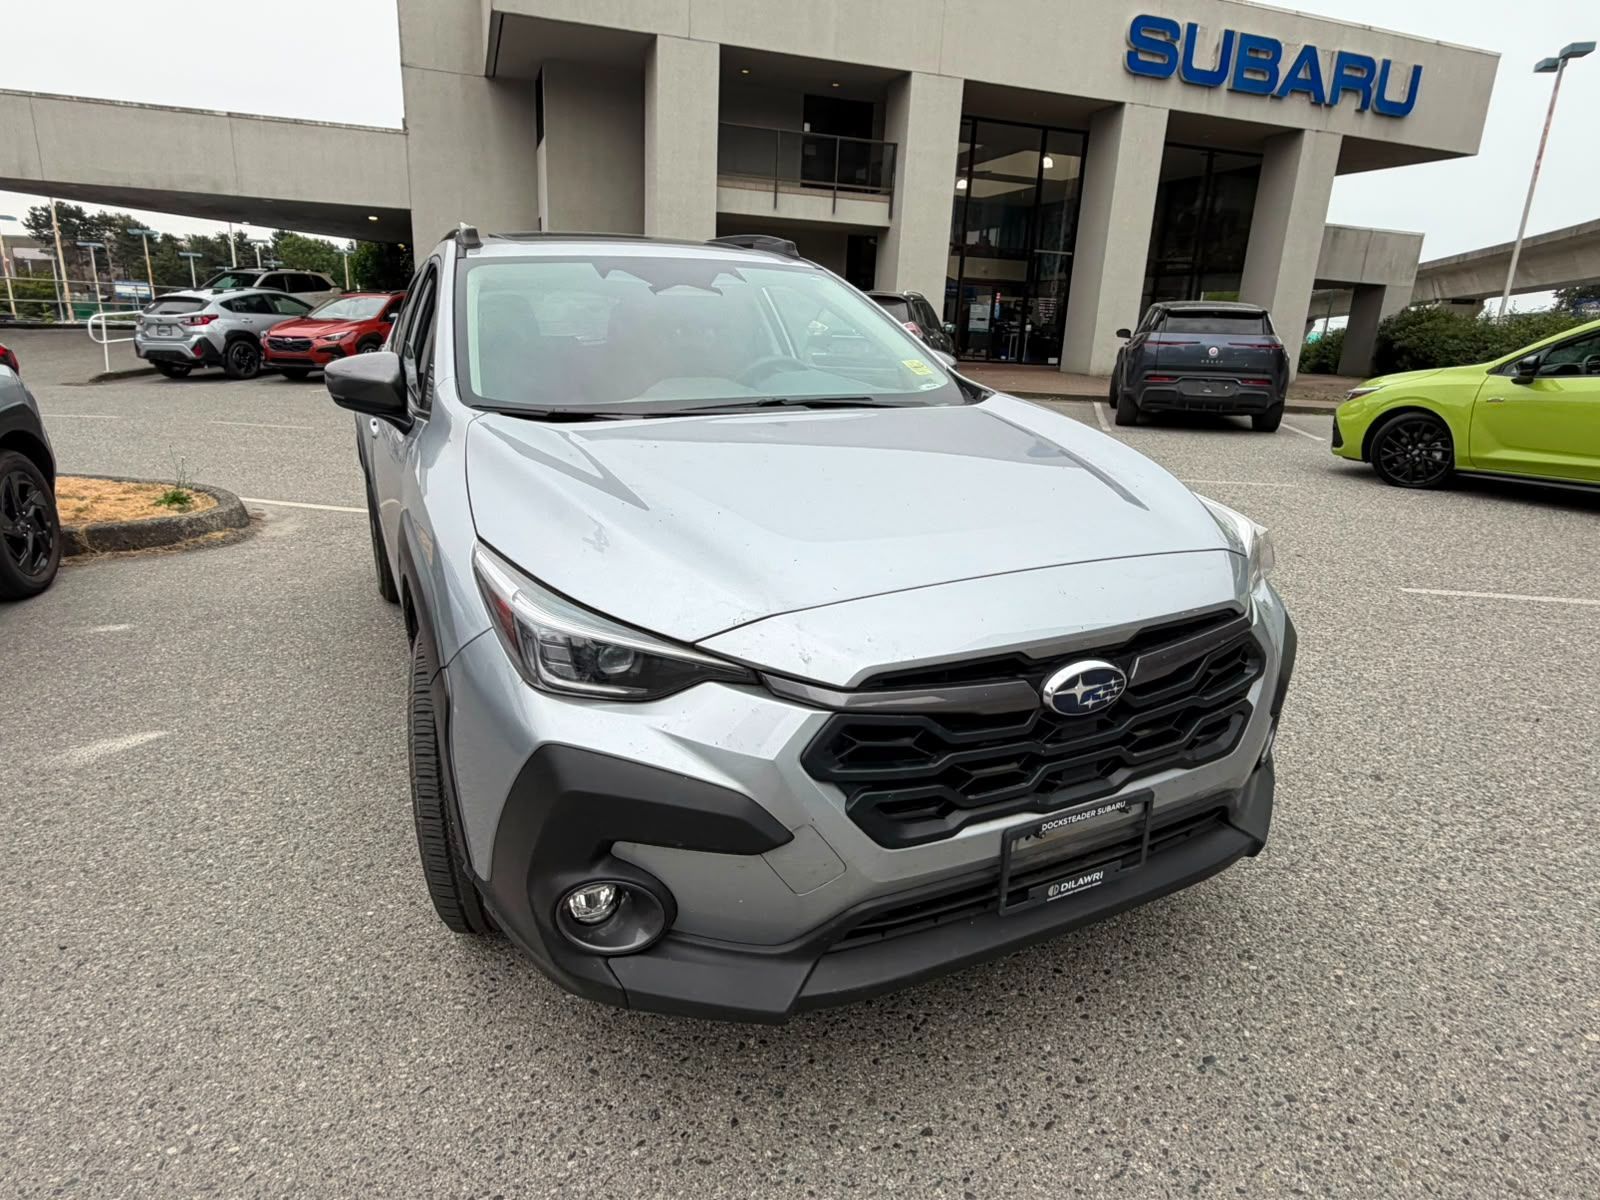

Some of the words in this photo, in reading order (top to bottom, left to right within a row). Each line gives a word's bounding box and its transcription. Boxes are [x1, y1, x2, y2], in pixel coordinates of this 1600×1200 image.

[1124, 13, 1424, 118] SUBARU
[1041, 809, 1096, 832] DOCKSTEADER
[1096, 800, 1127, 816] SUBARU
[1060, 870, 1104, 892] DILAWRI
